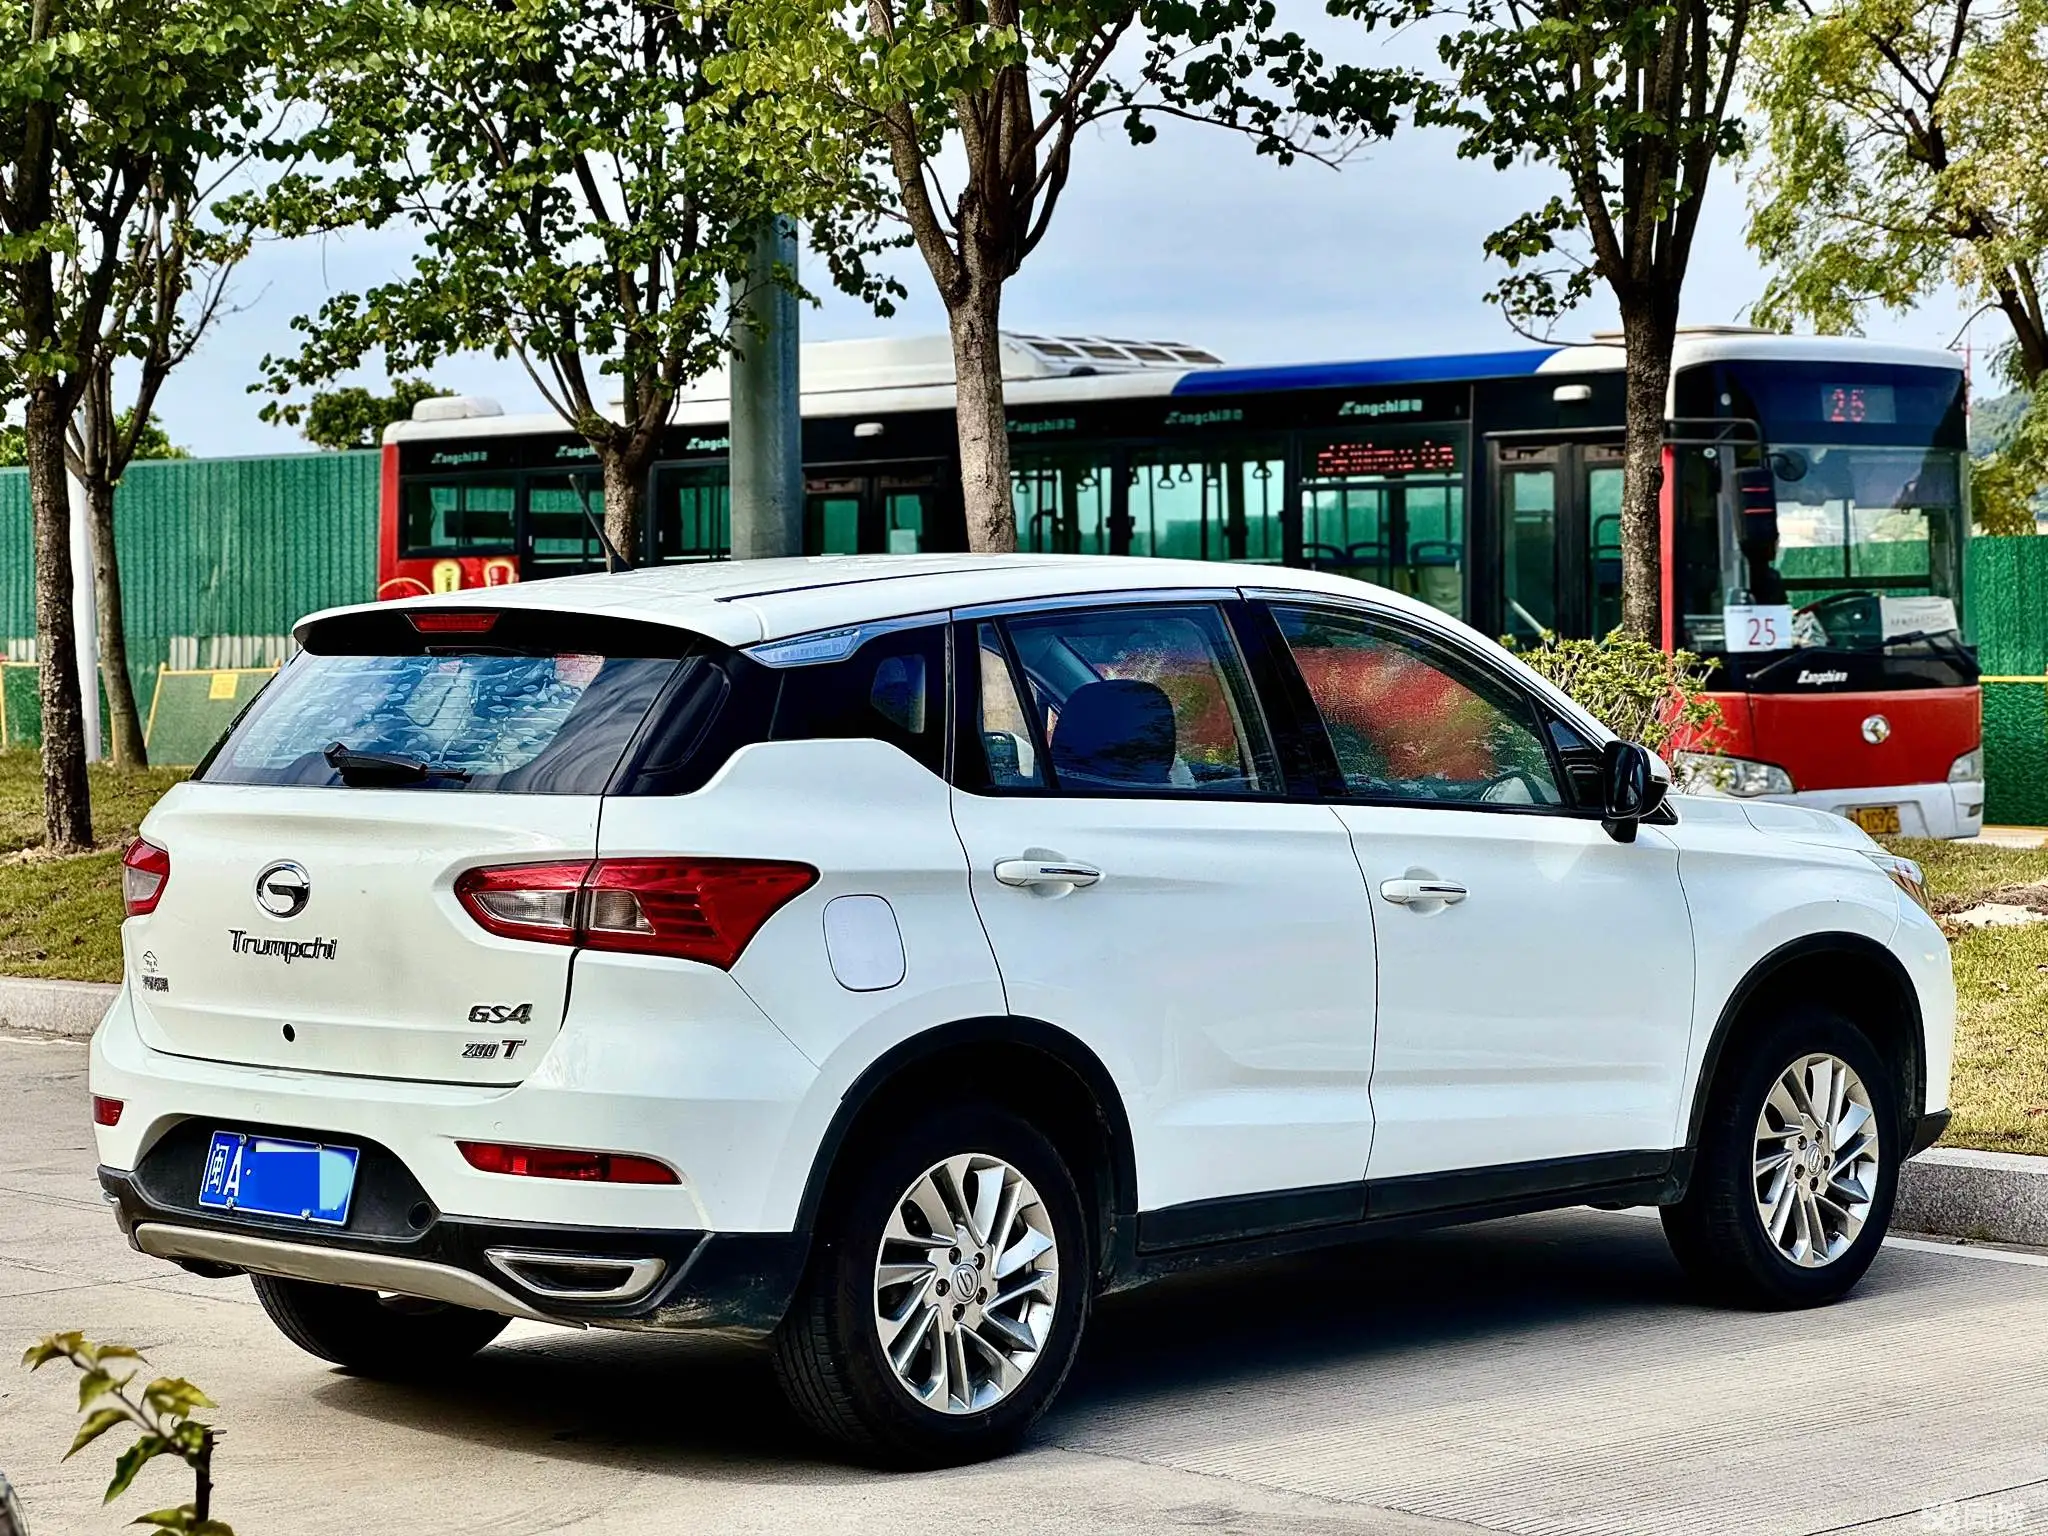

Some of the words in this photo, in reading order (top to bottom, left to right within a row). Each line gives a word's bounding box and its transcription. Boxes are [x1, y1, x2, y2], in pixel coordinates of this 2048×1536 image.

[1747, 618, 1776, 646] 25
[228, 929, 338, 964] Trumpchi
[468, 1003, 533, 1024] GS4
